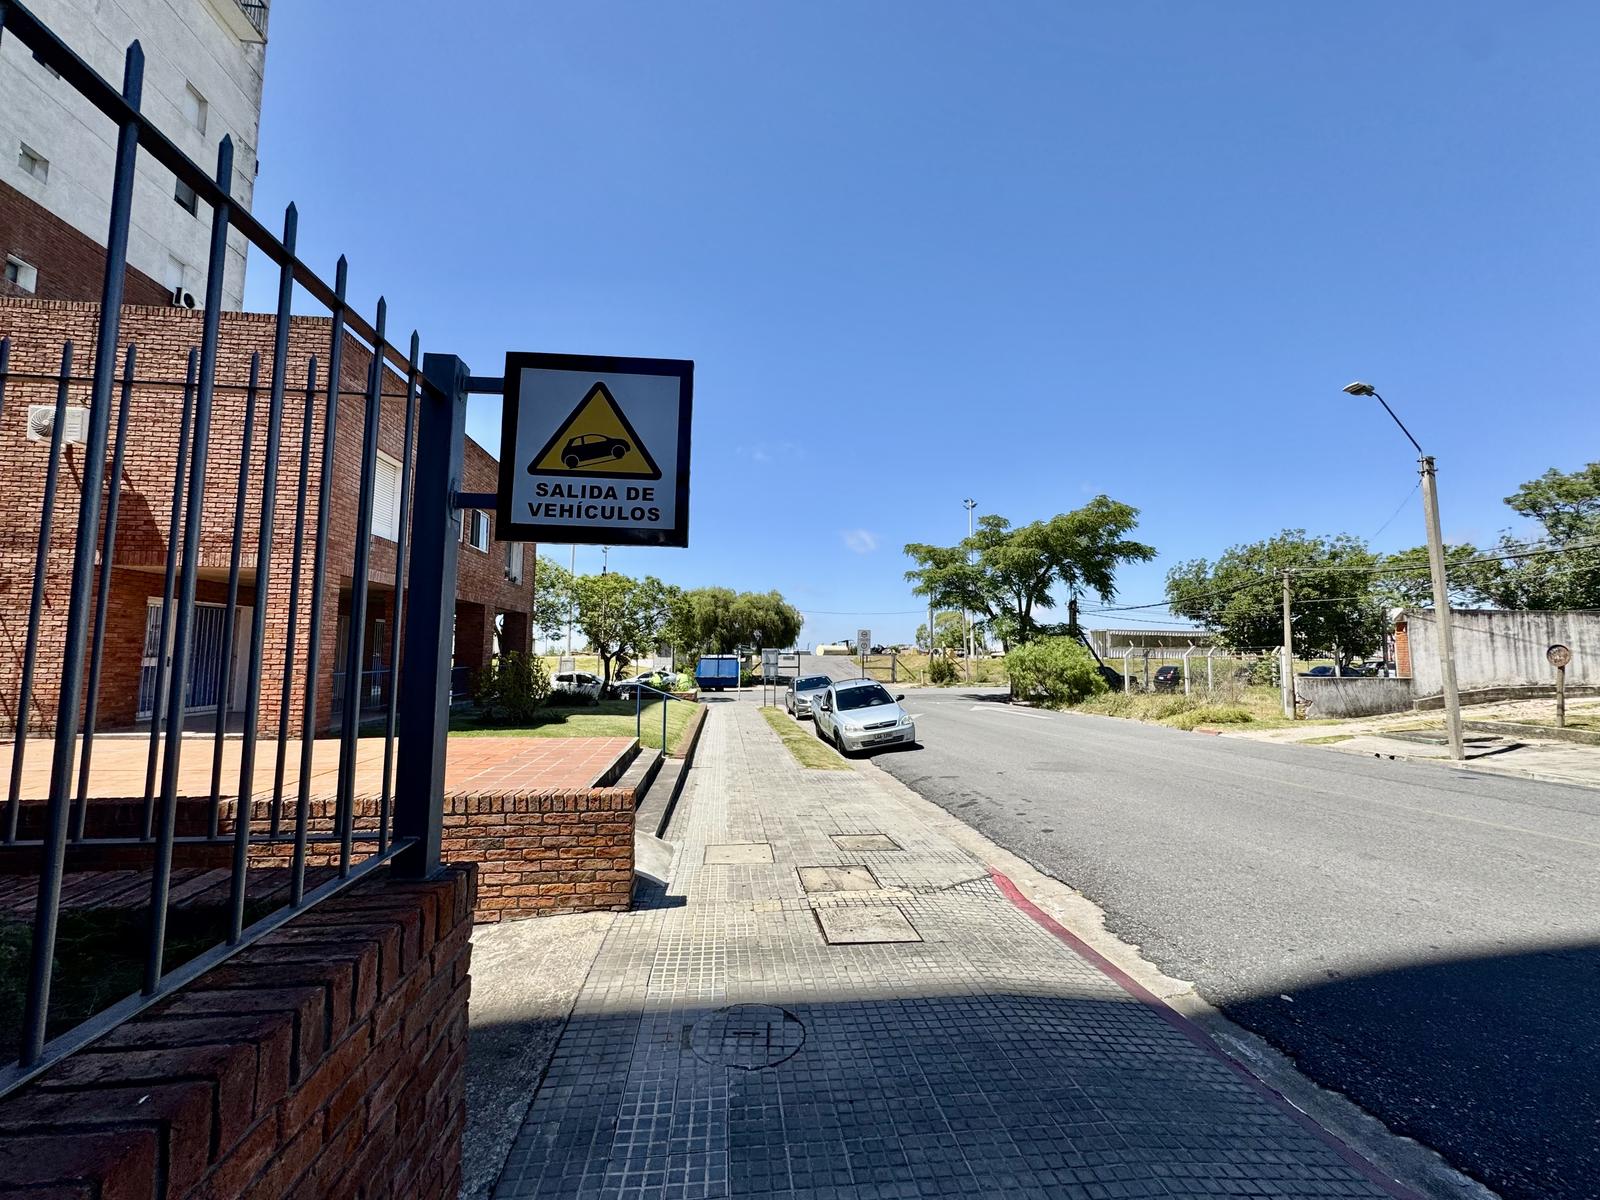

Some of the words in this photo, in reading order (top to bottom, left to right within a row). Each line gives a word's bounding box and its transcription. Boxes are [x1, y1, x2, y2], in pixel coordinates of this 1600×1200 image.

[535, 482, 618, 500] SALIDA
[626, 486, 655, 502] DE
[527, 501, 660, 522] VEHÍCULOS
